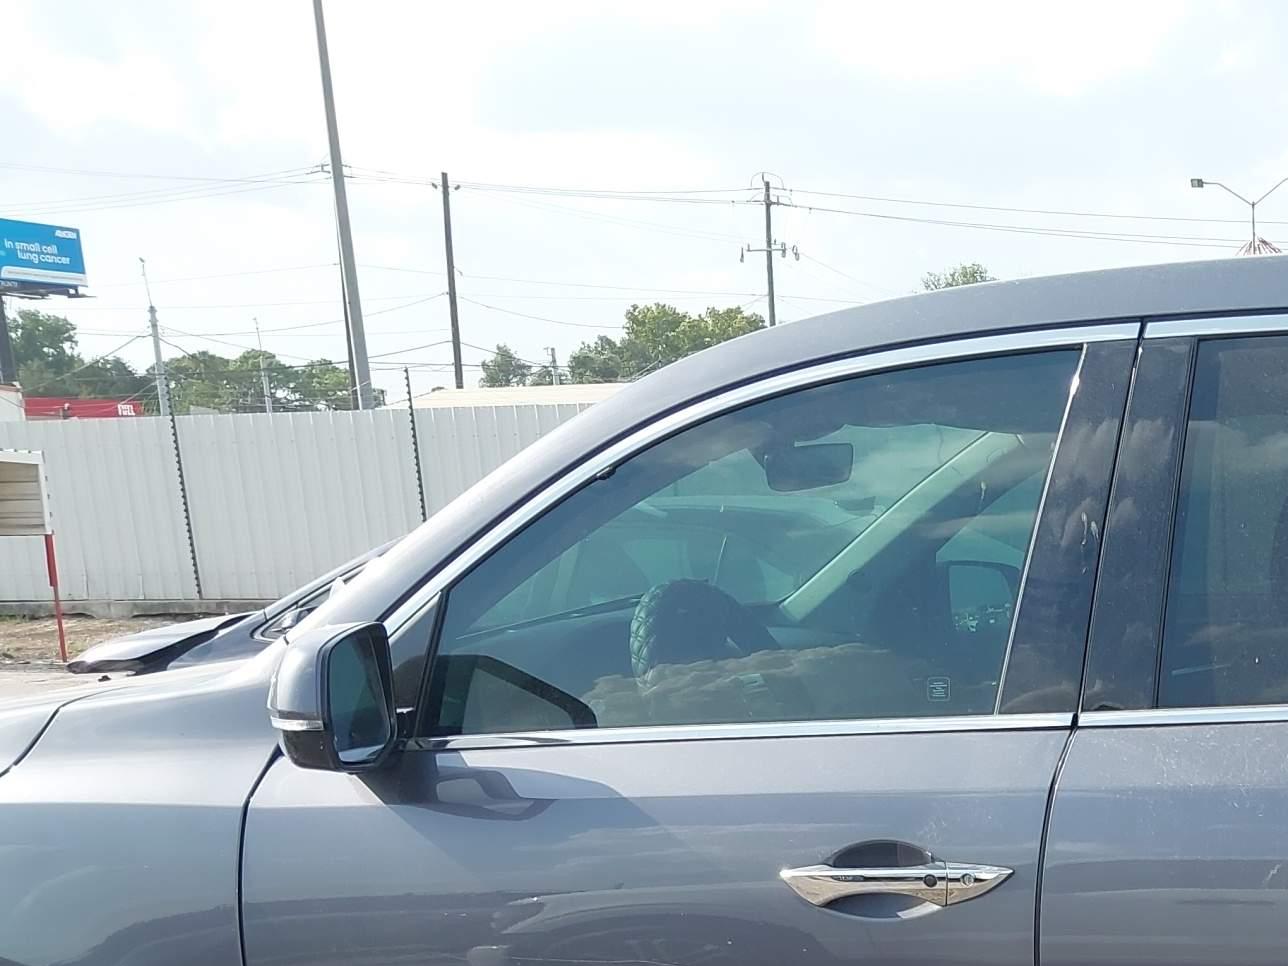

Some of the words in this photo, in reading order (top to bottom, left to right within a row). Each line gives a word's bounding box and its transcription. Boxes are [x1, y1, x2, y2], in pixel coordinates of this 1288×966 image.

[4, 238, 14, 249] In
[15, 241, 40, 252] small
[42, 244, 58, 255] cell
[17, 249, 39, 264] lung
[40, 254, 71, 265] cancer
